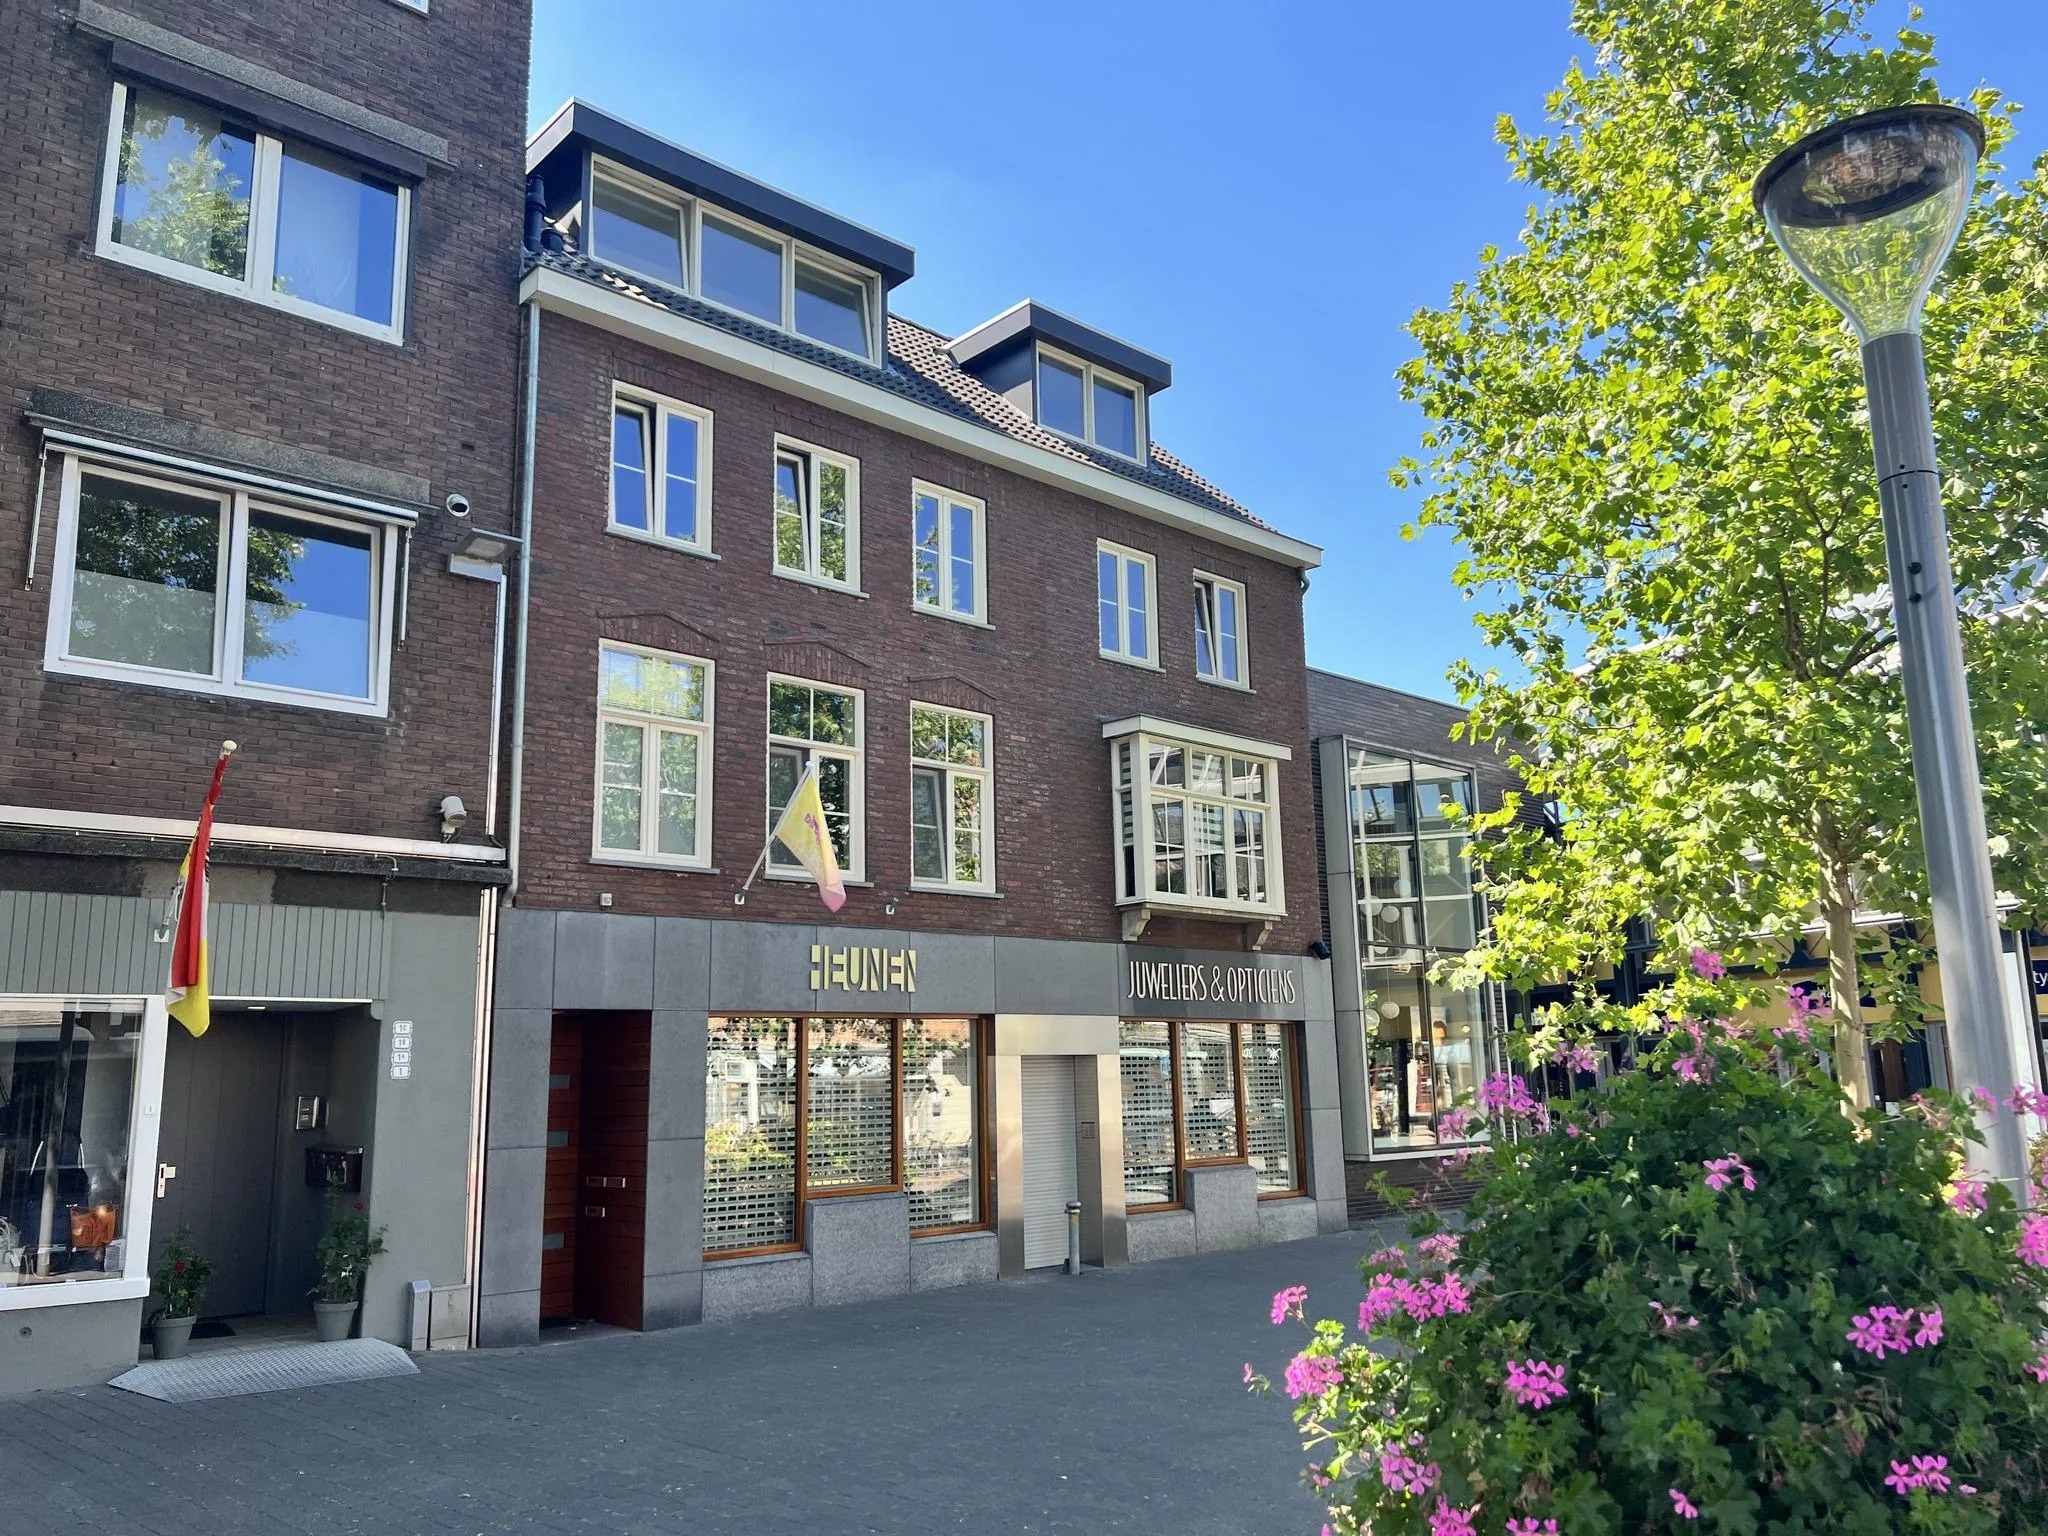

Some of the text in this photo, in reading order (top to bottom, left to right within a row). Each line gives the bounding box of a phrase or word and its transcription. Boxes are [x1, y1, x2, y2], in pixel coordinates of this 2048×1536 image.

[1128, 960, 1296, 1004] JUWELIERS & OPTICIENS
